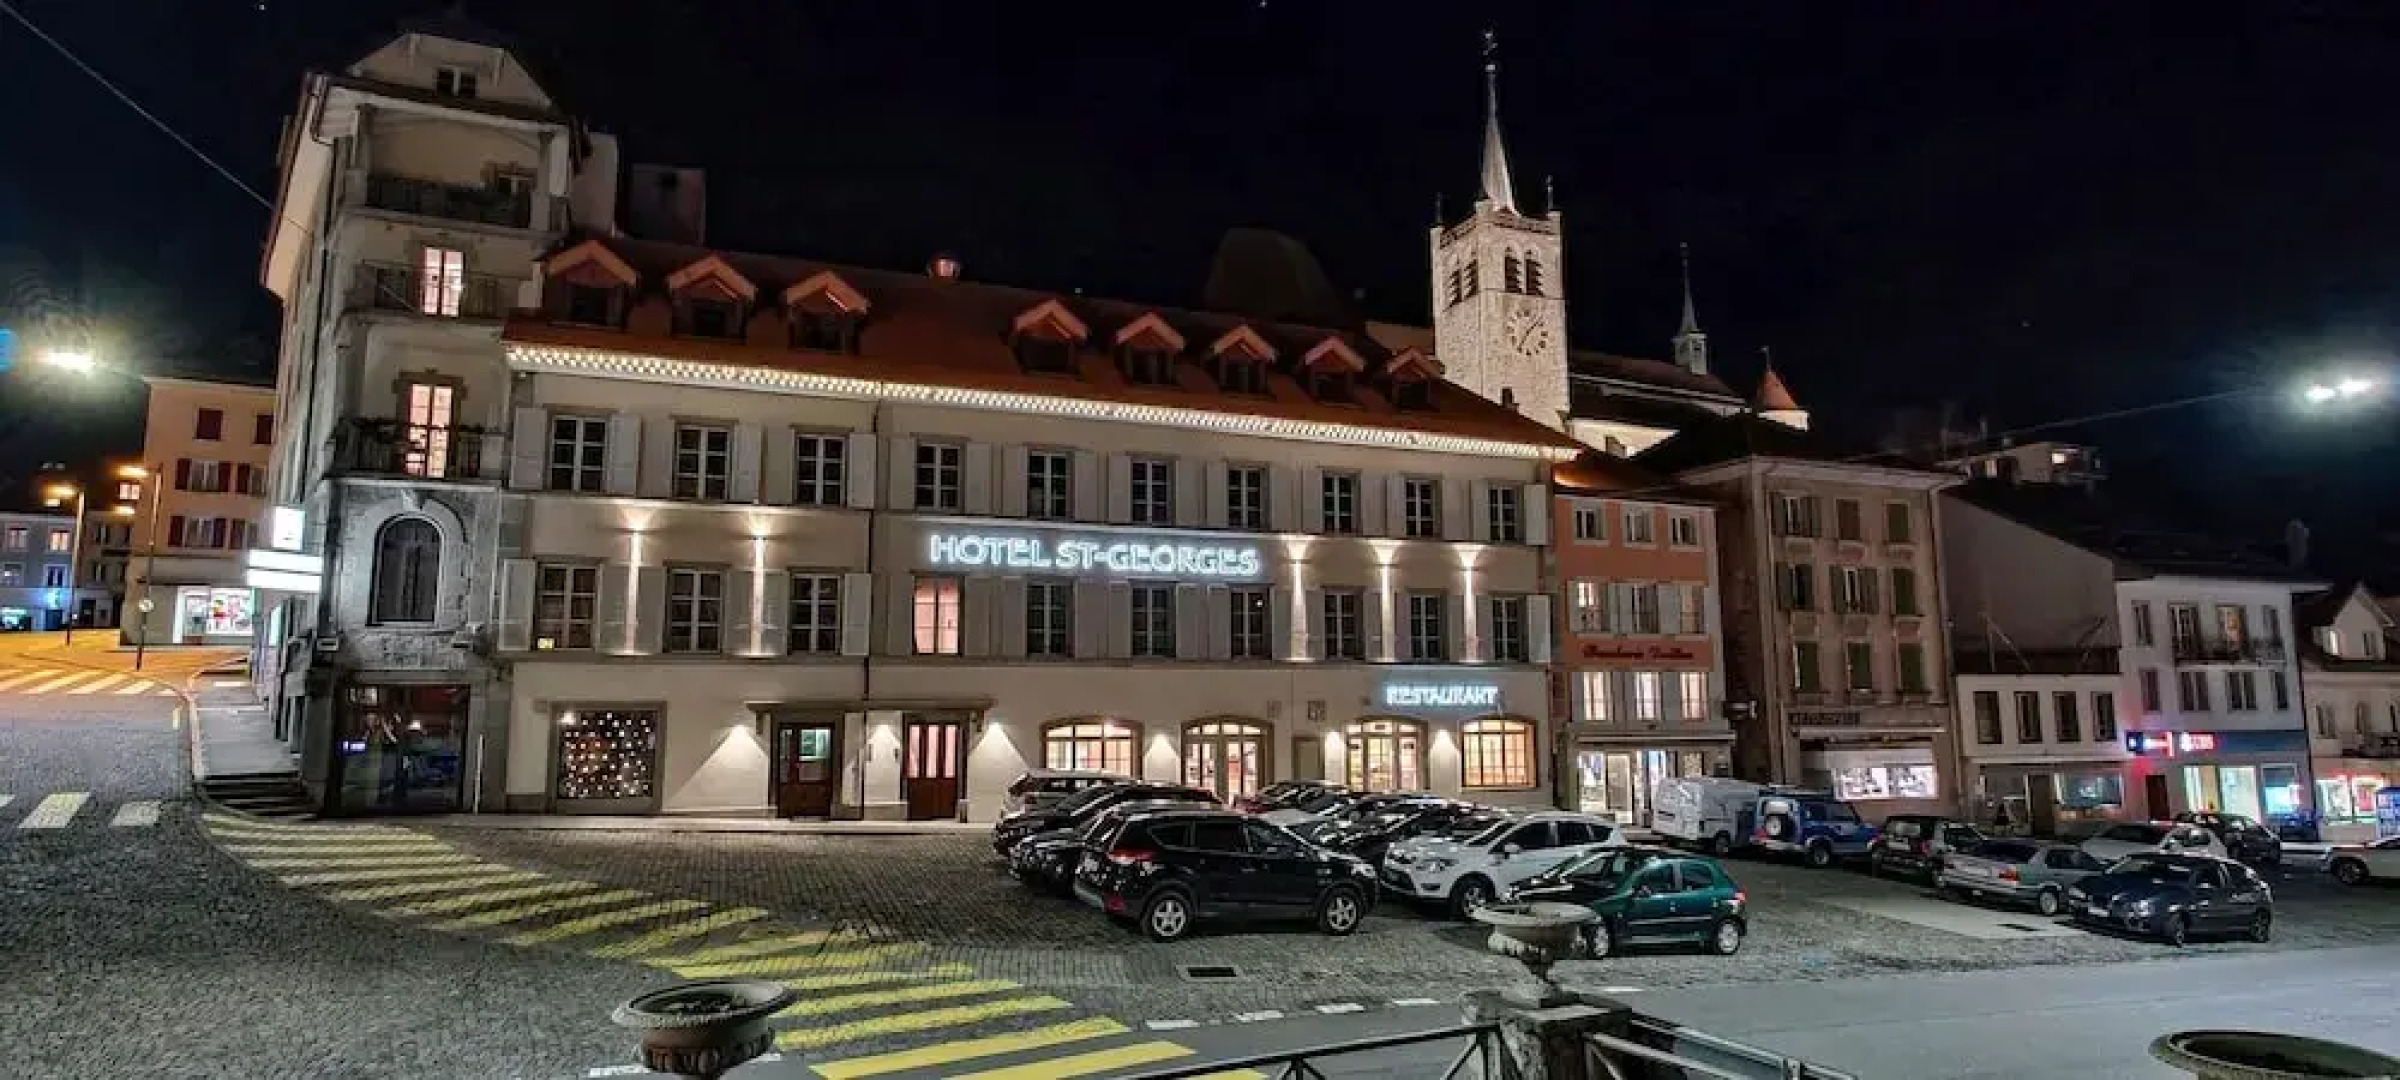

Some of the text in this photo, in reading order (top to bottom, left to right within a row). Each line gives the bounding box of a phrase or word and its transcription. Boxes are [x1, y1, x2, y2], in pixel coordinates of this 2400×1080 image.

[930, 534, 1258, 575] HOTEL ST-GEORGES
[1386, 685, 1498, 705] RESTAURANT
